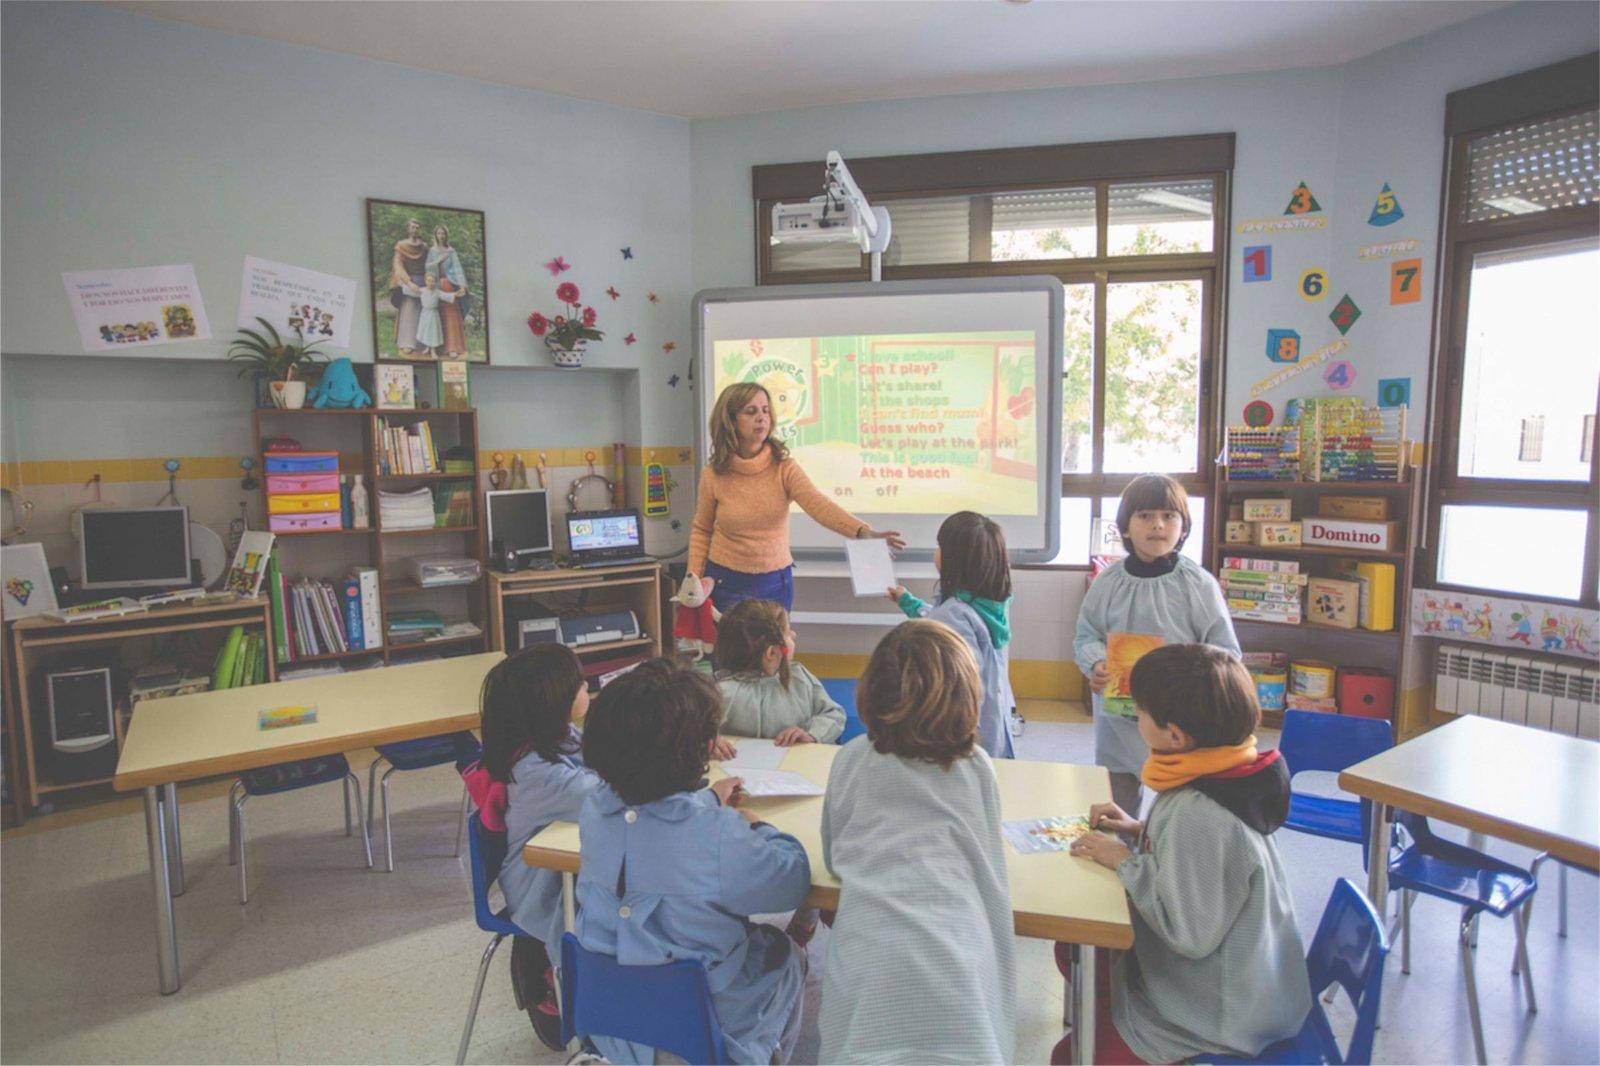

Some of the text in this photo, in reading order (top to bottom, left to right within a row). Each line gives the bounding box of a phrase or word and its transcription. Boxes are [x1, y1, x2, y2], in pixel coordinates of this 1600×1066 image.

[1290, 187, 1312, 214] 3
[1376, 191, 1398, 214] 5
[1244, 249, 1265, 276] 1
[1303, 272, 1323, 296] 6
[1396, 267, 1418, 292] 7
[1336, 303, 1353, 326] 2
[1279, 337, 1297, 361] 8
[751, 359, 804, 378] Power
[858, 362, 939, 377] Can I play?
[1328, 363, 1348, 386] 4
[860, 379, 942, 392] Let's share!
[879, 396, 903, 407] the
[907, 395, 949, 408] shops
[860, 421, 945, 434] Guess who?
[860, 437, 1018, 451] Let's play at the park!
[860, 467, 950, 479] At the beach
[834, 485, 899, 497] on off
[1311, 525, 1381, 544] Domino
